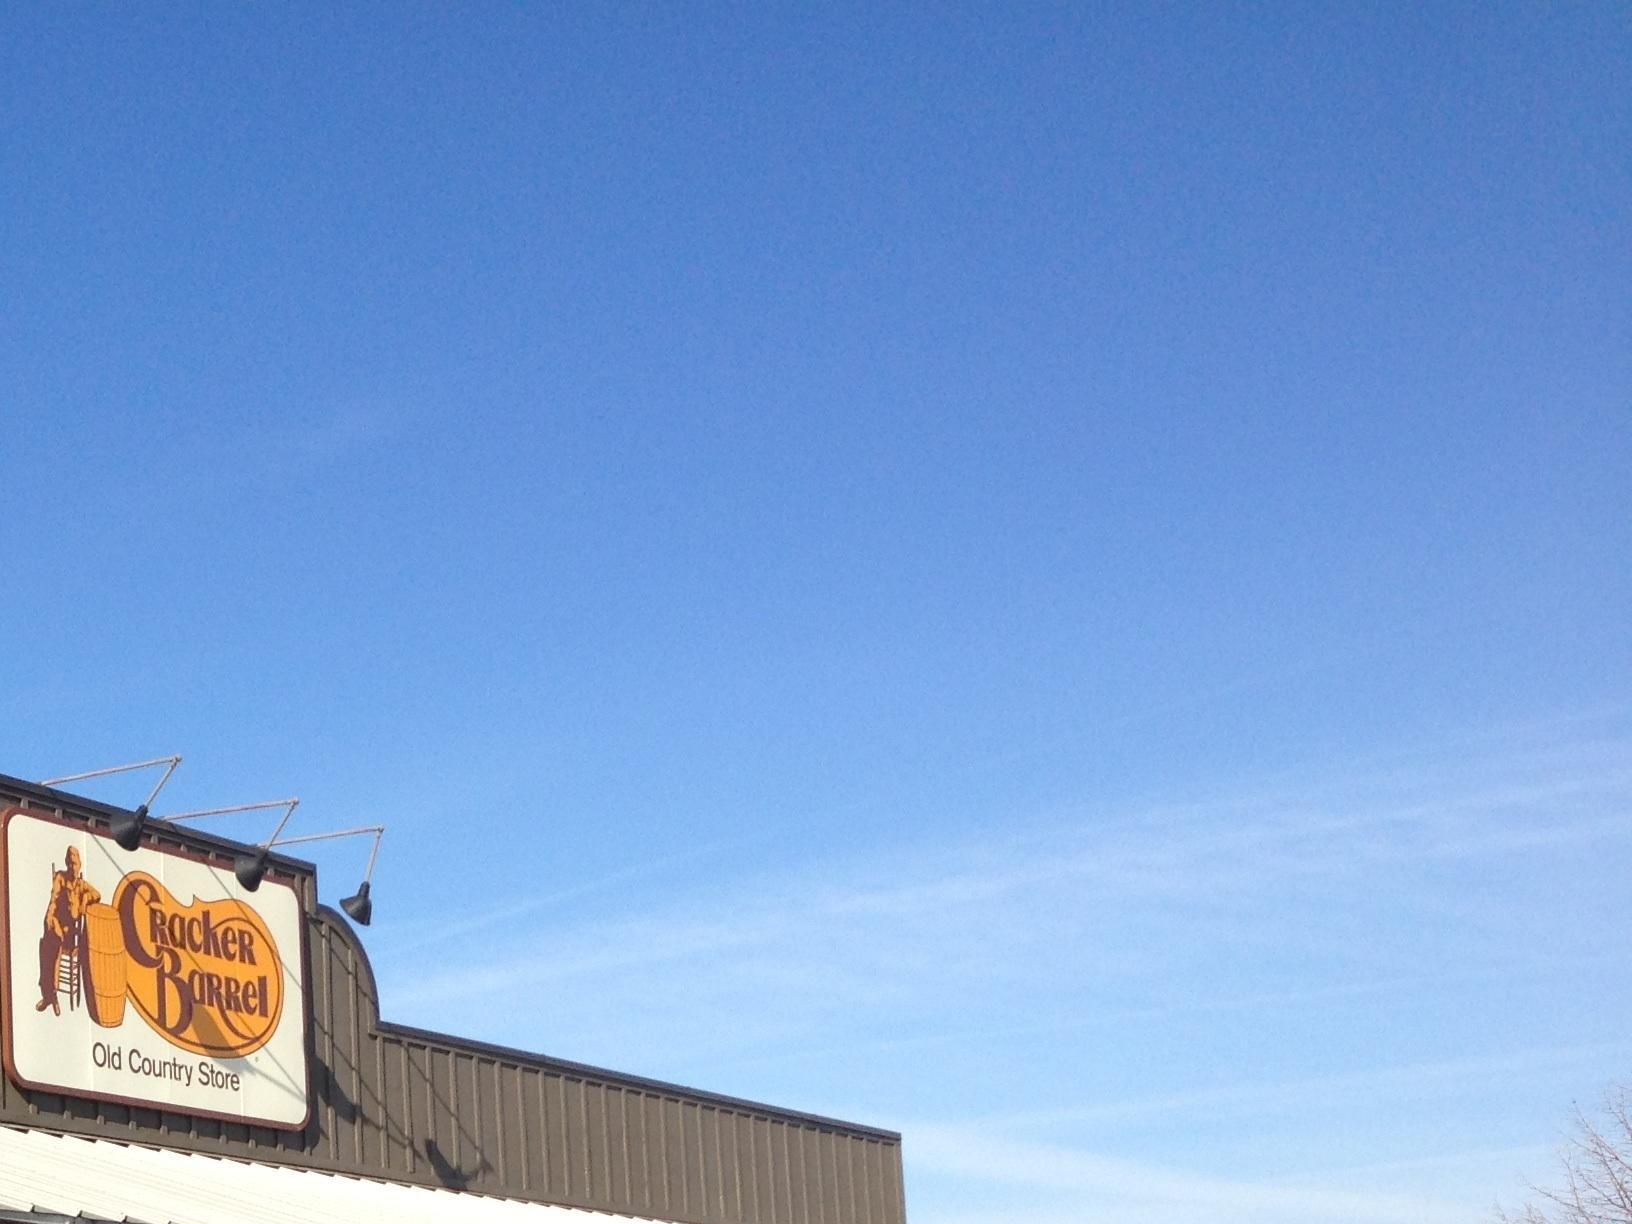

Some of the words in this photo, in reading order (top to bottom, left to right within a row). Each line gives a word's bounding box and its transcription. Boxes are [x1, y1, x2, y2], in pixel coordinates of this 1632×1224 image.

[119, 879, 256, 968] Cracker
[155, 947, 268, 1035] Barrel
[92, 1042, 122, 1070] Old
[128, 1050, 193, 1087] Country
[198, 1061, 241, 1091] Store
